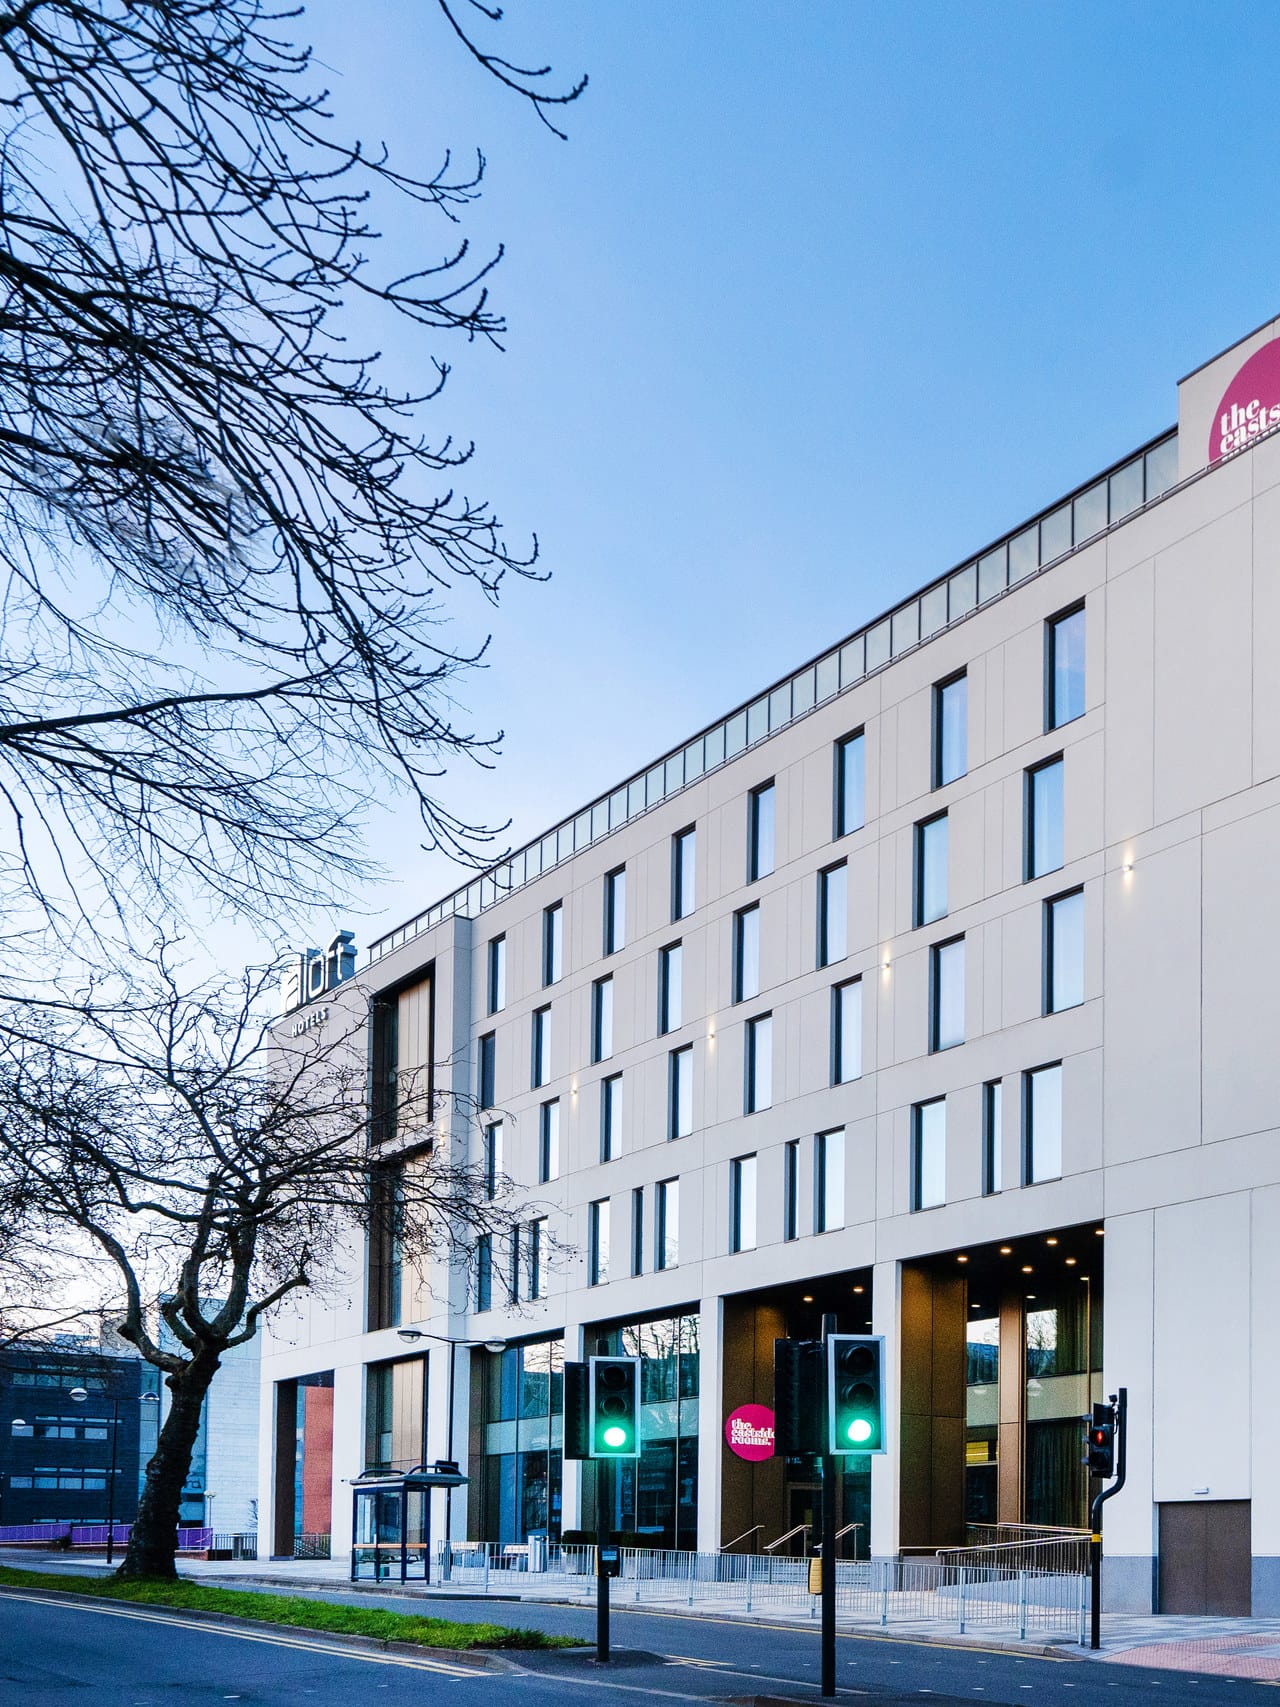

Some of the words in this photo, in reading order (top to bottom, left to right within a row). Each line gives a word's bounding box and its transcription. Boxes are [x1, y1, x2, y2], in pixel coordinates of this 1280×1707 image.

[1220, 399, 1260, 436] the
[291, 1006, 329, 1038] HOTELS
[731, 1418, 752, 1430] the
[731, 1436, 772, 1446] rooms.
